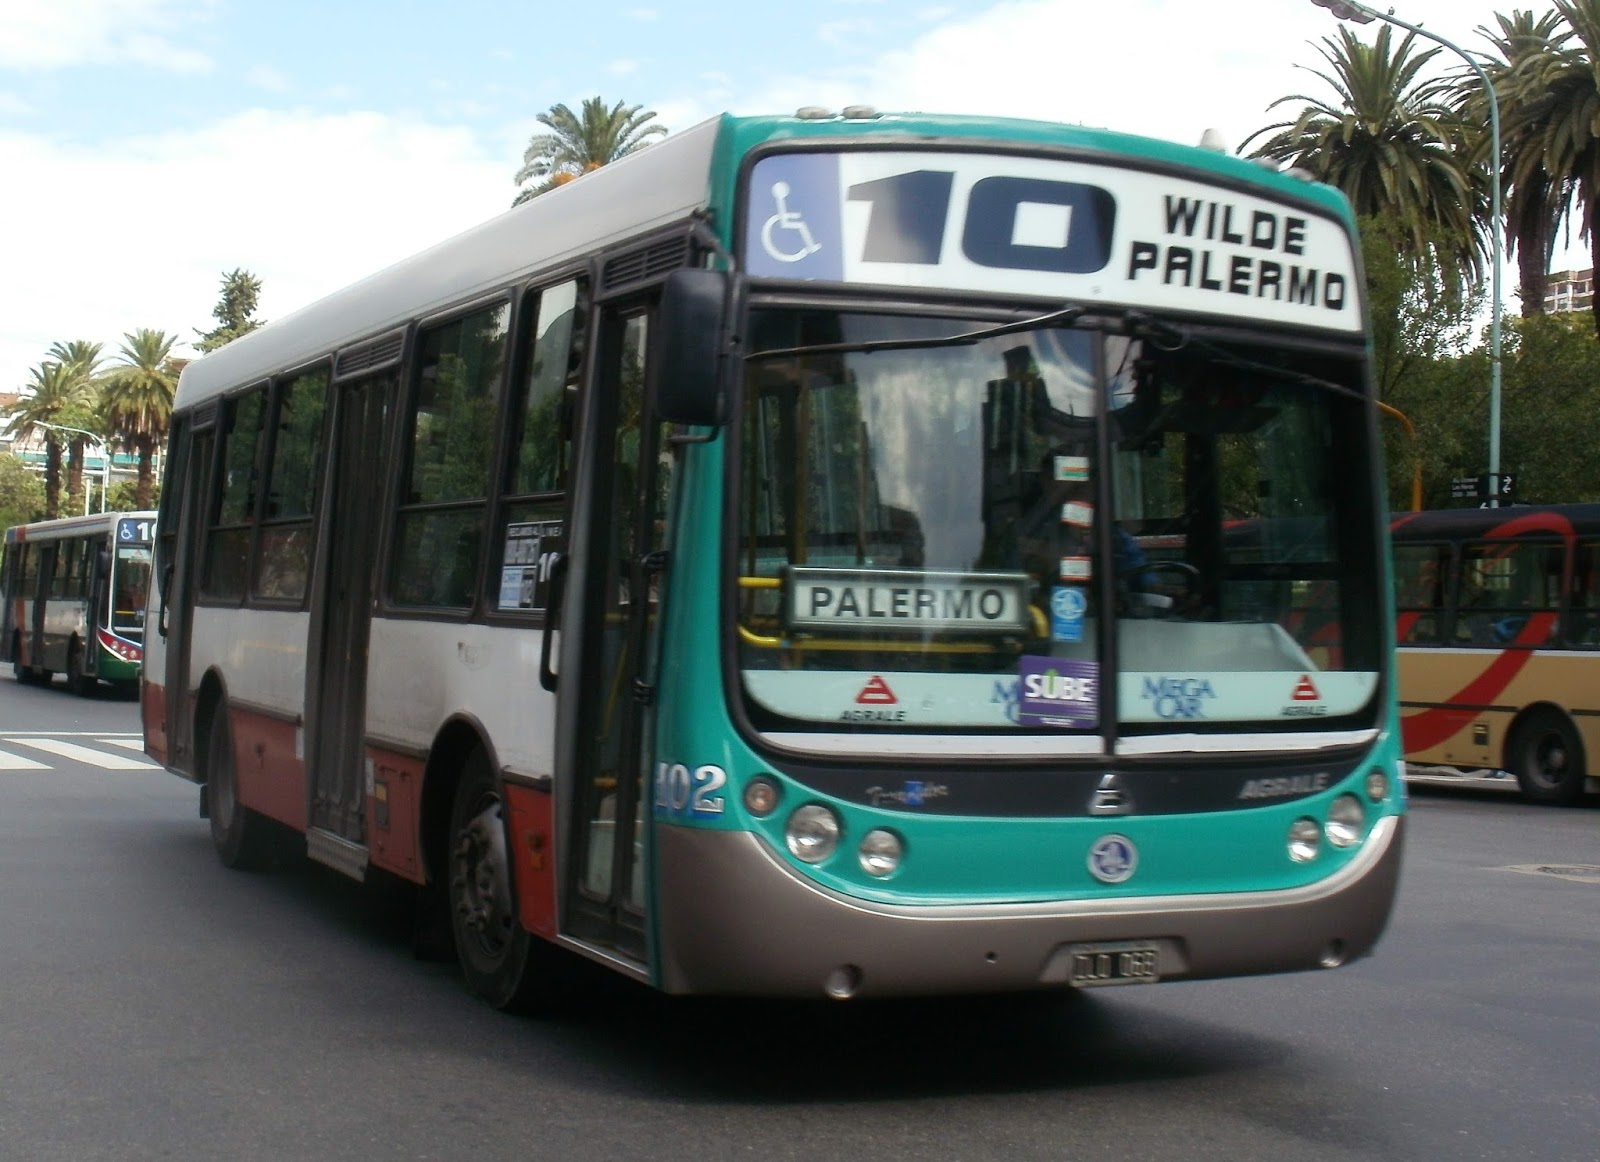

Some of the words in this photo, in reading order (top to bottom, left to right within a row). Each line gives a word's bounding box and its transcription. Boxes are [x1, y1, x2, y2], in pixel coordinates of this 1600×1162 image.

[847, 169, 1117, 275] 10
[1164, 194, 1307, 256] WILDE
[1127, 240, 1346, 311] PALERMO
[811, 586, 1005, 620] PALERMO
[1024, 672, 1095, 702] SUBE
[1140, 678, 1217, 699] MEGA
[840, 709, 907, 722] AGRALE
